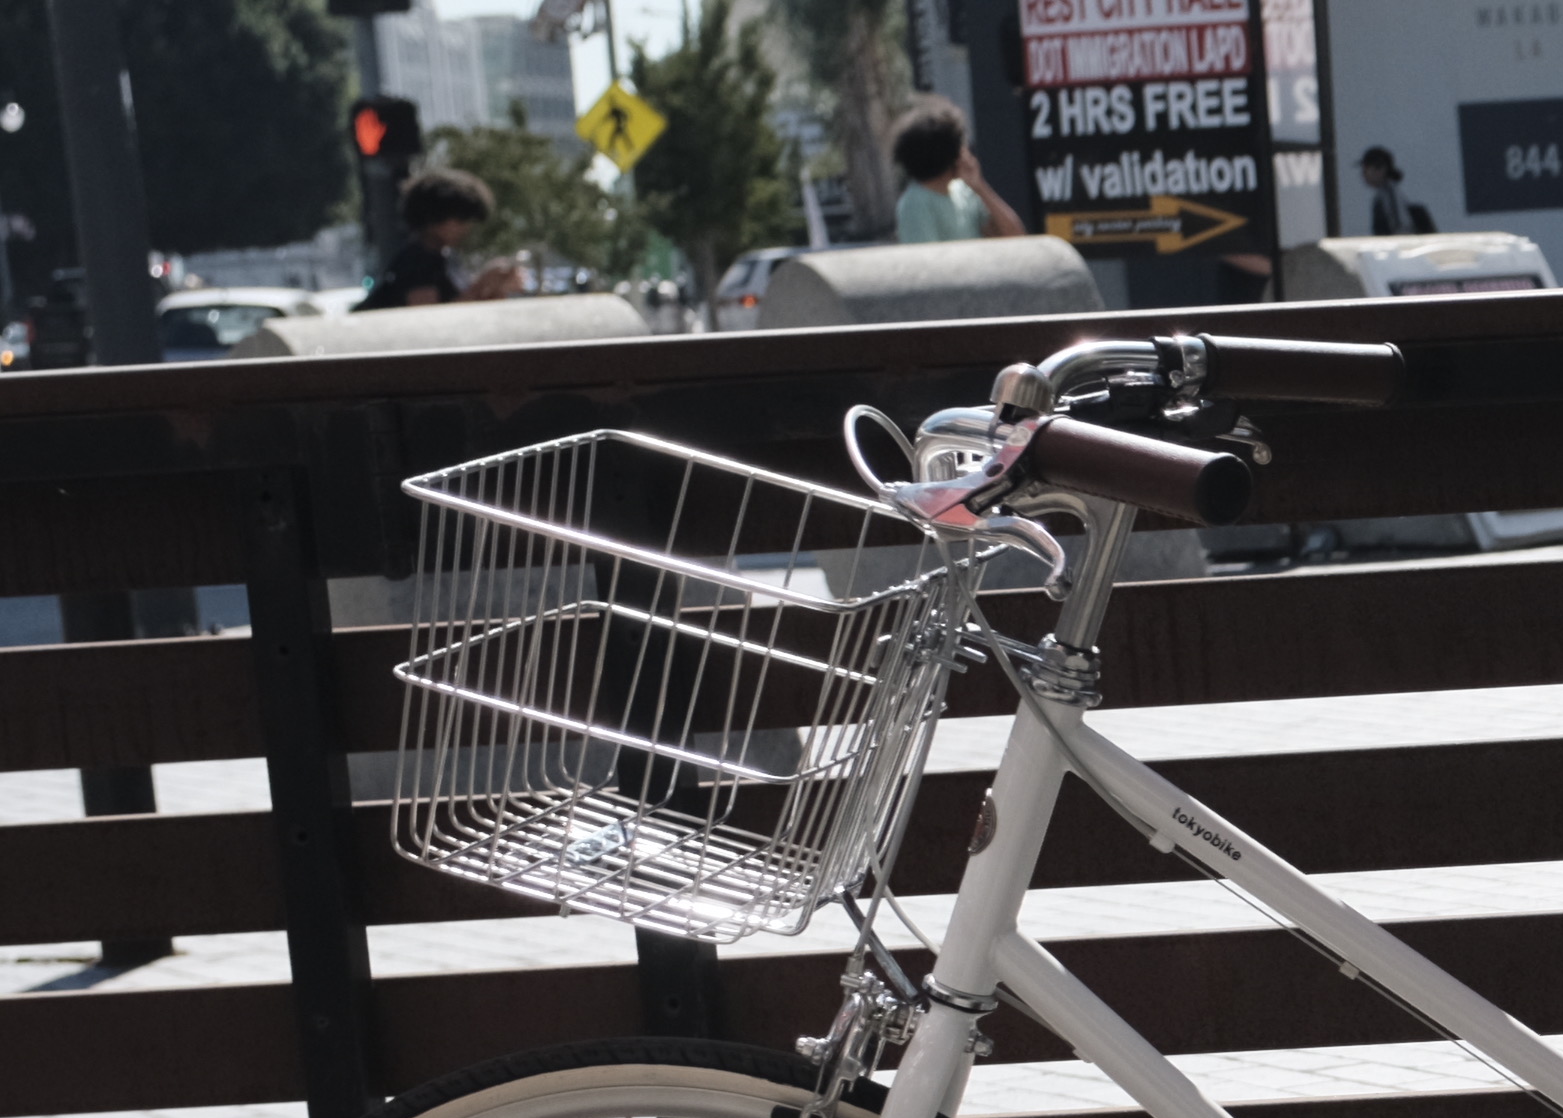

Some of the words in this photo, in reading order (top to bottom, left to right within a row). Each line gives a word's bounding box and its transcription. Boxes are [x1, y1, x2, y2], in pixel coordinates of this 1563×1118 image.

[1189, 24, 1247, 73] LAPD
[1031, 89, 1053, 139] 2
[1058, 84, 1136, 137] HRS
[1143, 77, 1252, 131] FREE
[1034, 154, 1074, 201] w/
[1080, 149, 1258, 199] validation
[1172, 807, 1242, 860] tokyobike
